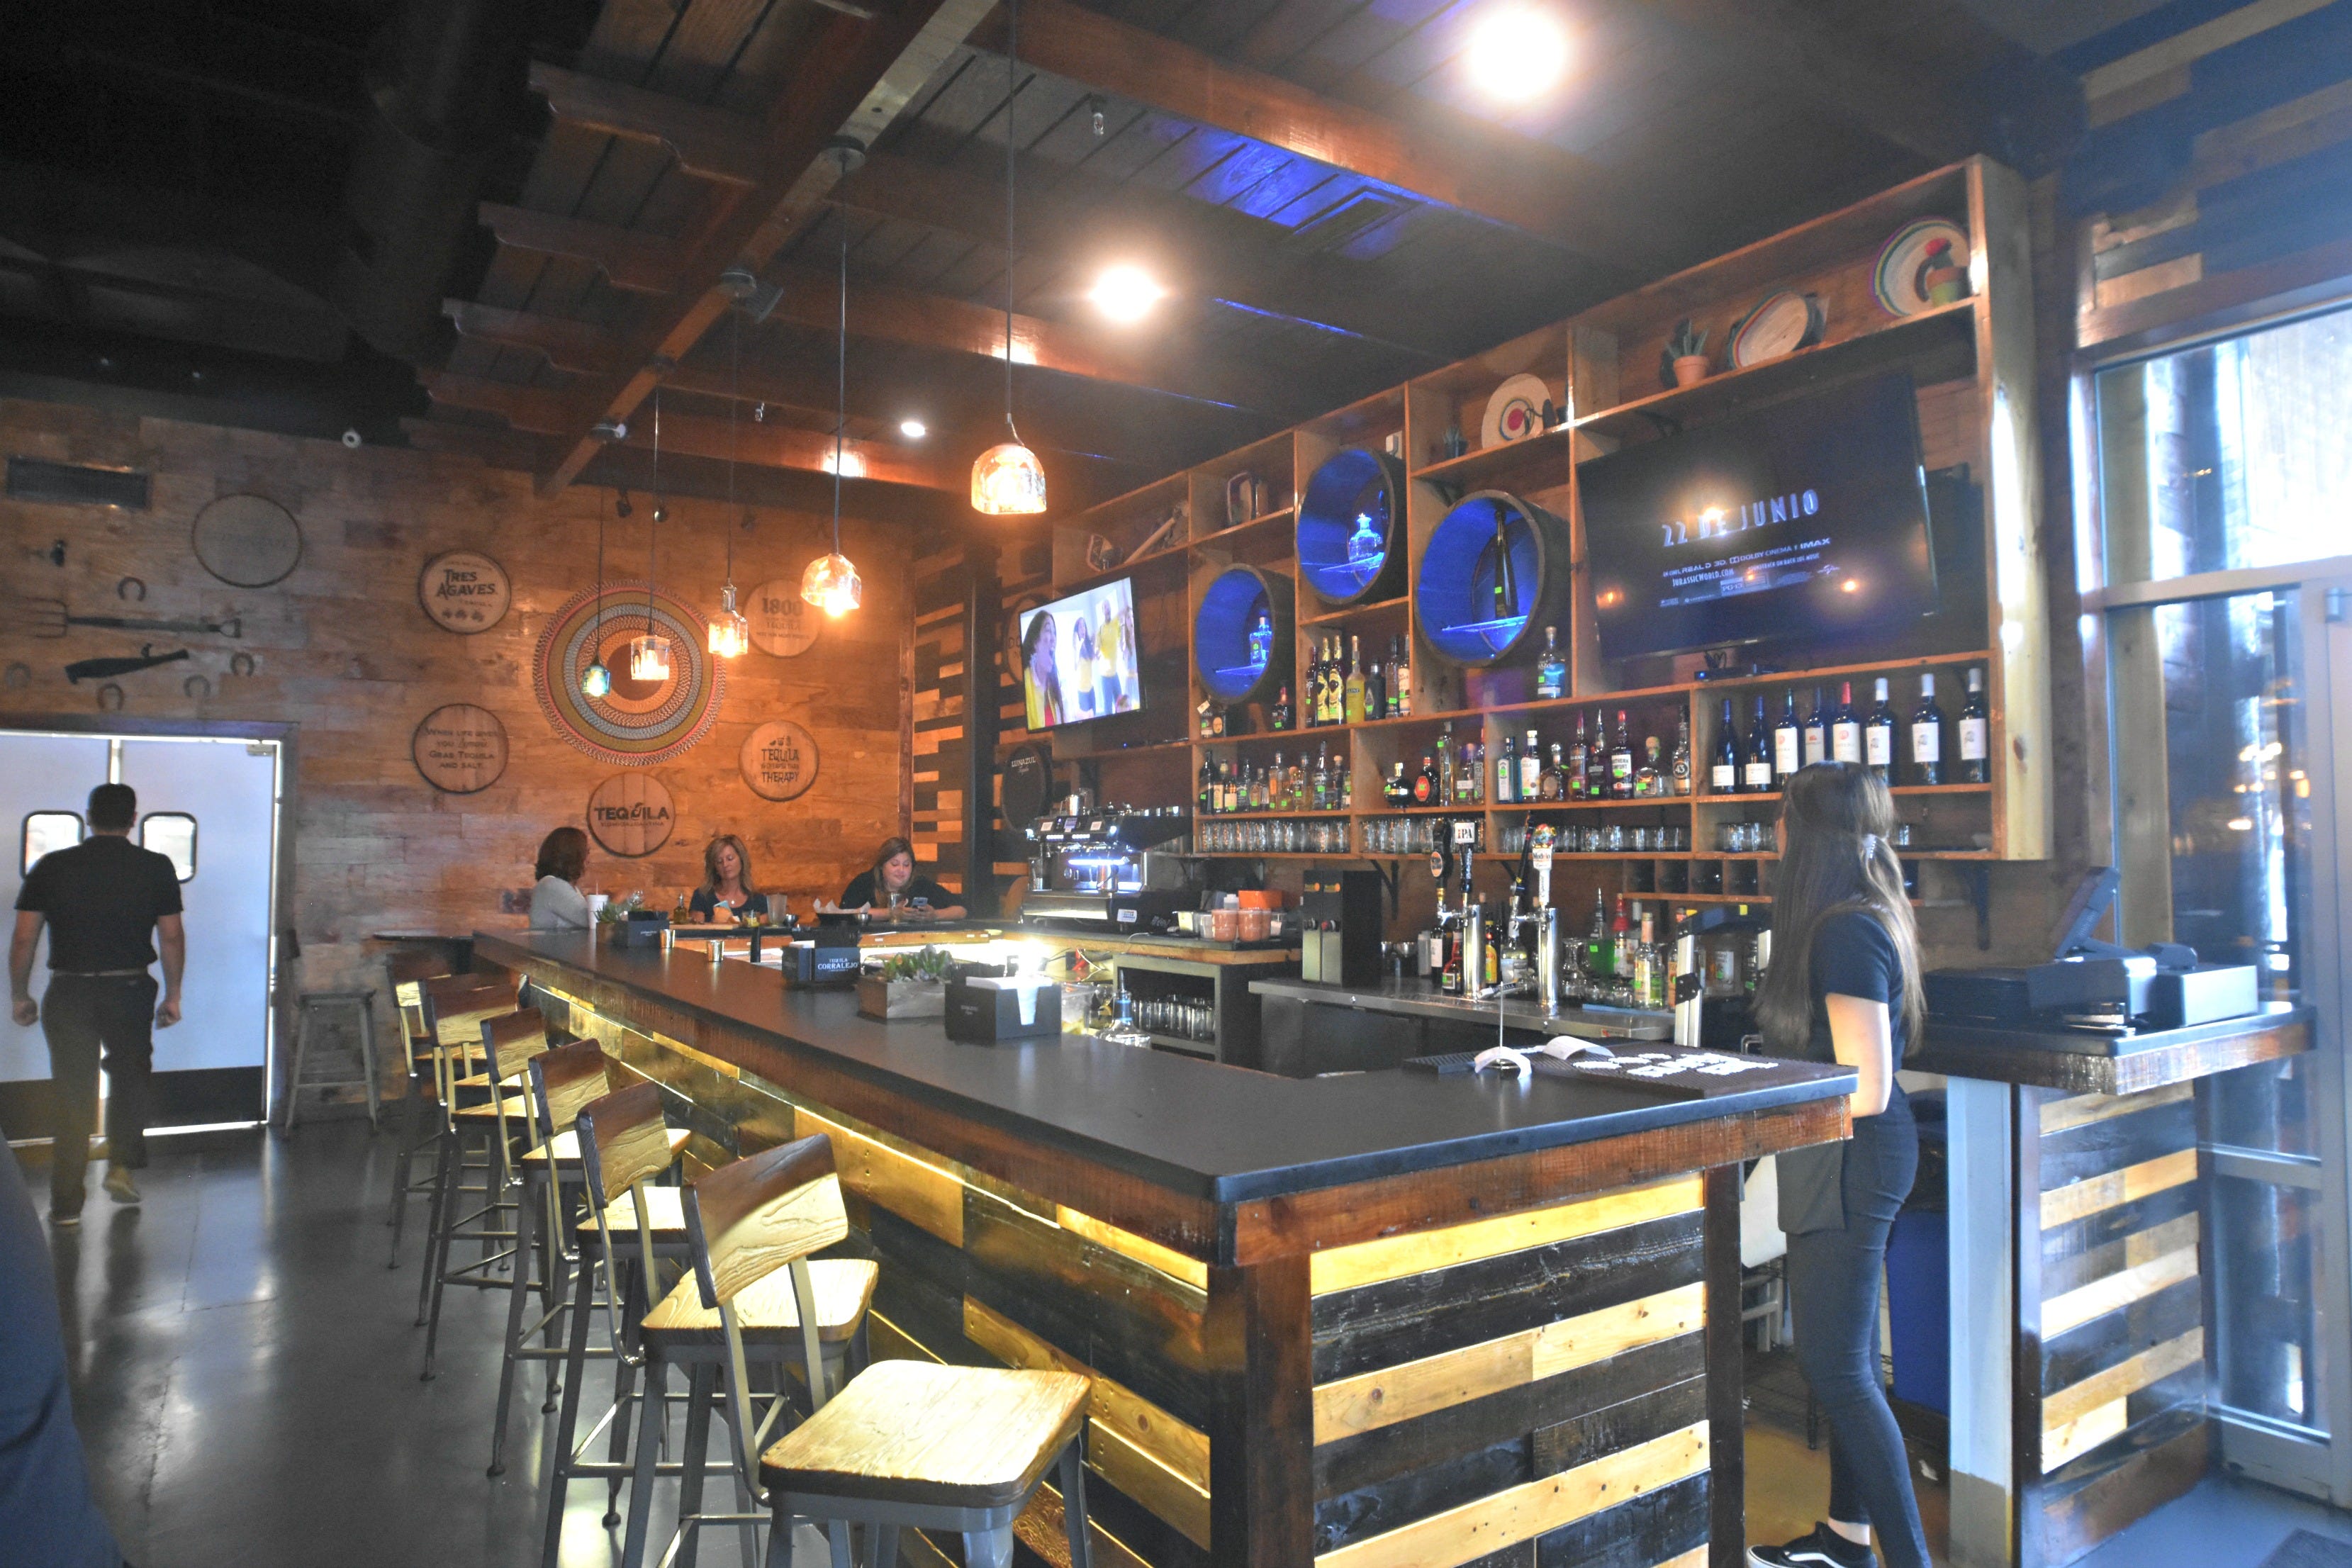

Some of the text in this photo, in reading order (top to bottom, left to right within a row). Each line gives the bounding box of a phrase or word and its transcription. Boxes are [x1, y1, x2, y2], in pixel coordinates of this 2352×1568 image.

[1661, 521, 1688, 547] 22
[1740, 488, 1819, 531] JUNIO
[1740, 550, 1764, 561] DOLBY
[1765, 546, 1793, 556] CINEMA
[1800, 537, 1831, 550] IMAX
[443, 569, 478, 585] TRES
[436, 582, 496, 600] AGAVES
[1722, 582, 1743, 592] PG-13
[762, 598, 804, 617] 1800
[761, 749, 800, 762] TEQUILA
[1012, 756, 1036, 767] LUNAZUL
[1675, 765, 1685, 773] 43
[761, 772, 800, 784] THERAPY
[594, 802, 670, 821] TEQUILA
[1457, 828, 1472, 839] IPA
